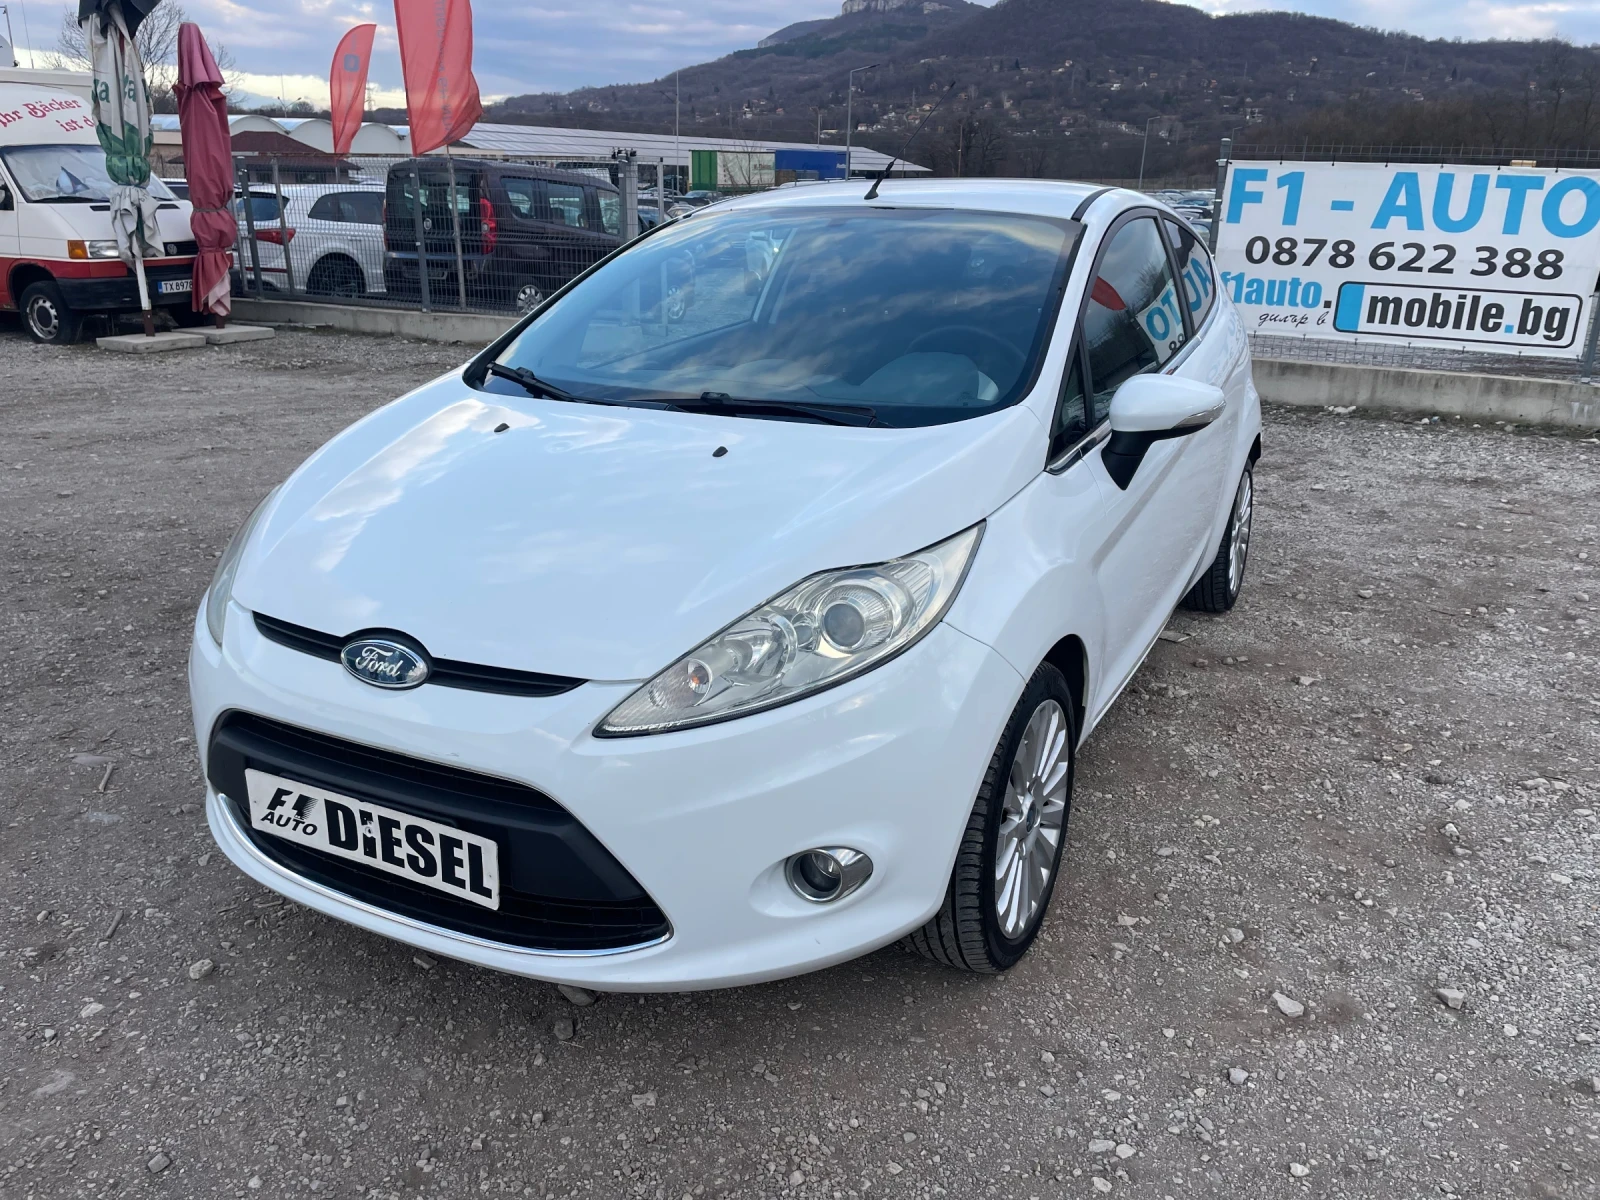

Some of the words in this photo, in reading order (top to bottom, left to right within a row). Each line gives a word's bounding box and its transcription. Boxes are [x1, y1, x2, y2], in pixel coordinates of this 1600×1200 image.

[0, 110, 23, 128] hr
[22, 98, 82, 118] Bäcker
[55, 118, 83, 132] ist
[1227, 169, 1304, 225] F1
[1371, 172, 1600, 238] AUTO
[1245, 235, 1356, 269] 0878
[1368, 241, 1457, 274] 622
[1470, 246, 1564, 280] 388
[163, 282, 175, 292] TX
[1366, 292, 1570, 342] mobile.bg
[355, 646, 403, 678] Ford
[266, 787, 318, 820] F1
[260, 811, 318, 836] AUTO
[323, 798, 493, 900] DIESEL
